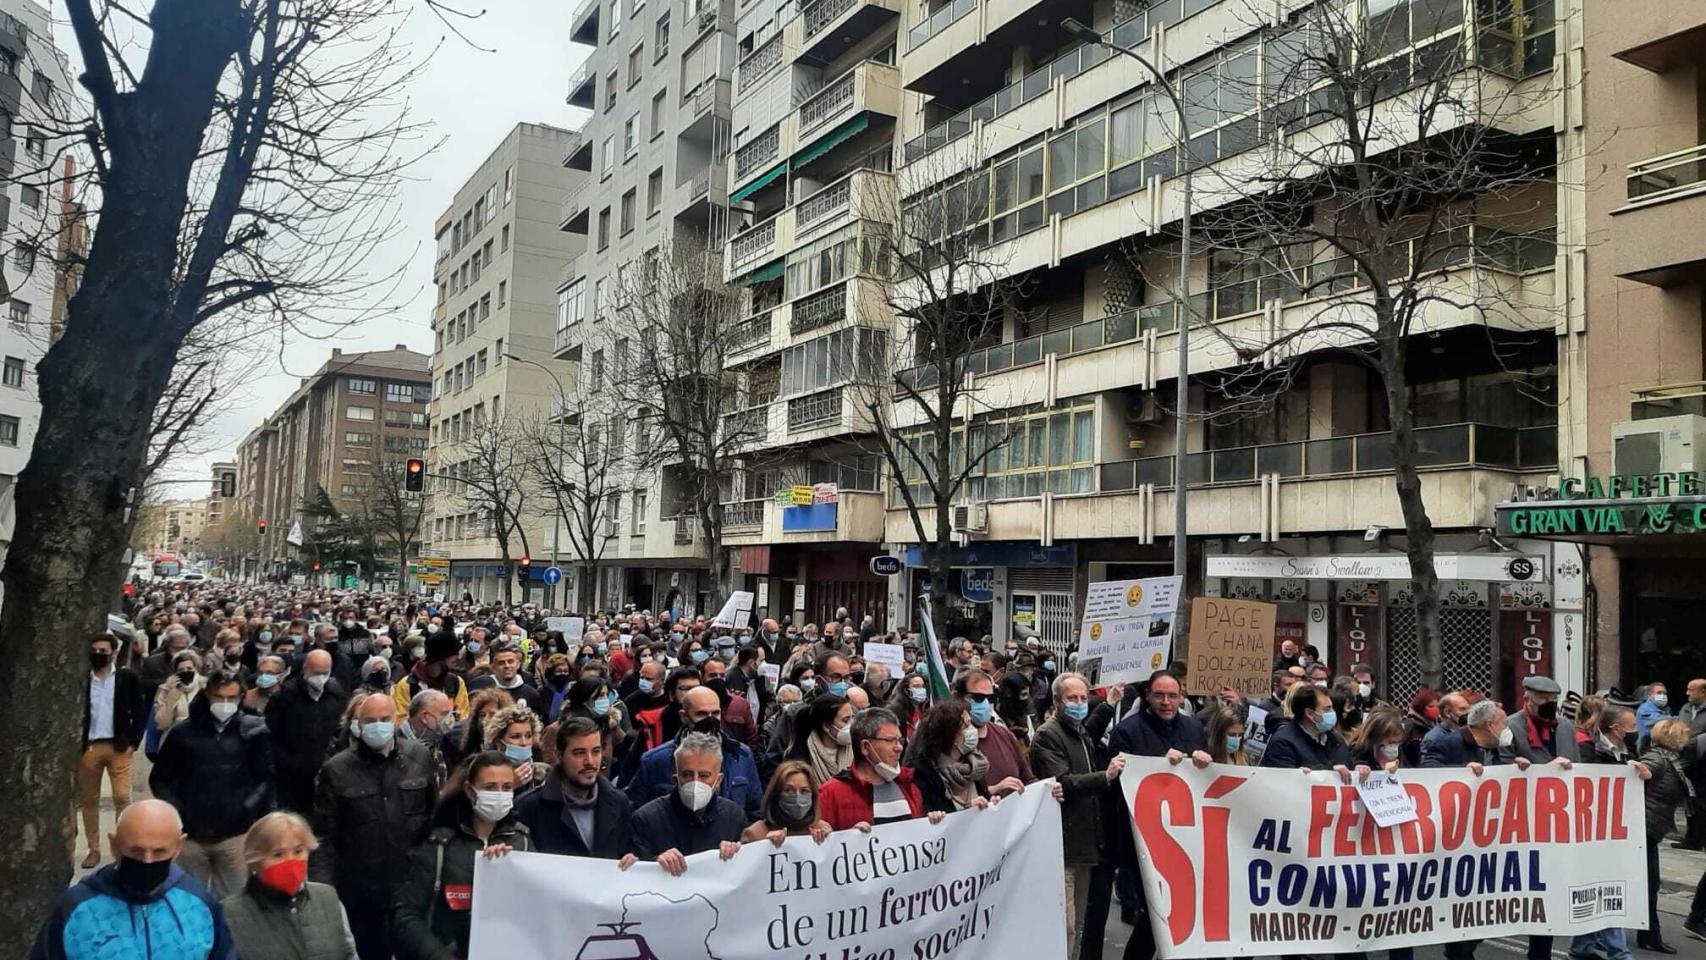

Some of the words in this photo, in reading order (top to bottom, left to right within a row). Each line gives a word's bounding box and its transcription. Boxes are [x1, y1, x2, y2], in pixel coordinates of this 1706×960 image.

[1559, 471, 1706, 500] CAFETE
[1510, 507, 1575, 534] GRAN
[1579, 505, 1626, 533] VIA
[876, 561, 897, 571] beds
[1513, 562, 1530, 574] SS
[967, 570, 995, 592] beds
[1128, 622, 1145, 631] TREN
[1204, 602, 1261, 630] PAGE
[1086, 645, 1110, 656] MUERE
[1117, 643, 1126, 651] LA
[1208, 630, 1265, 652] CHANA
[1522, 610, 1544, 675] LIQUI
[1101, 661, 1142, 673] CONQUENSE
[1197, 655, 1234, 672] DOLZ
[1241, 656, 1269, 672] PSOE
[1195, 672, 1223, 692] IROS
[1252, 818, 1292, 854] AL
[767, 851, 820, 894] En
[832, 836, 946, 887] defensa
[1248, 849, 1547, 909] CONVENCIONAL
[1603, 898, 1623, 911] TREN
[767, 904, 814, 950] de
[827, 903, 868, 941] un
[981, 904, 996, 940] y
[1250, 912, 1337, 942] MADRID
[1358, 905, 1434, 940] CUENCA
[1452, 897, 1547, 929] VALENCIA
